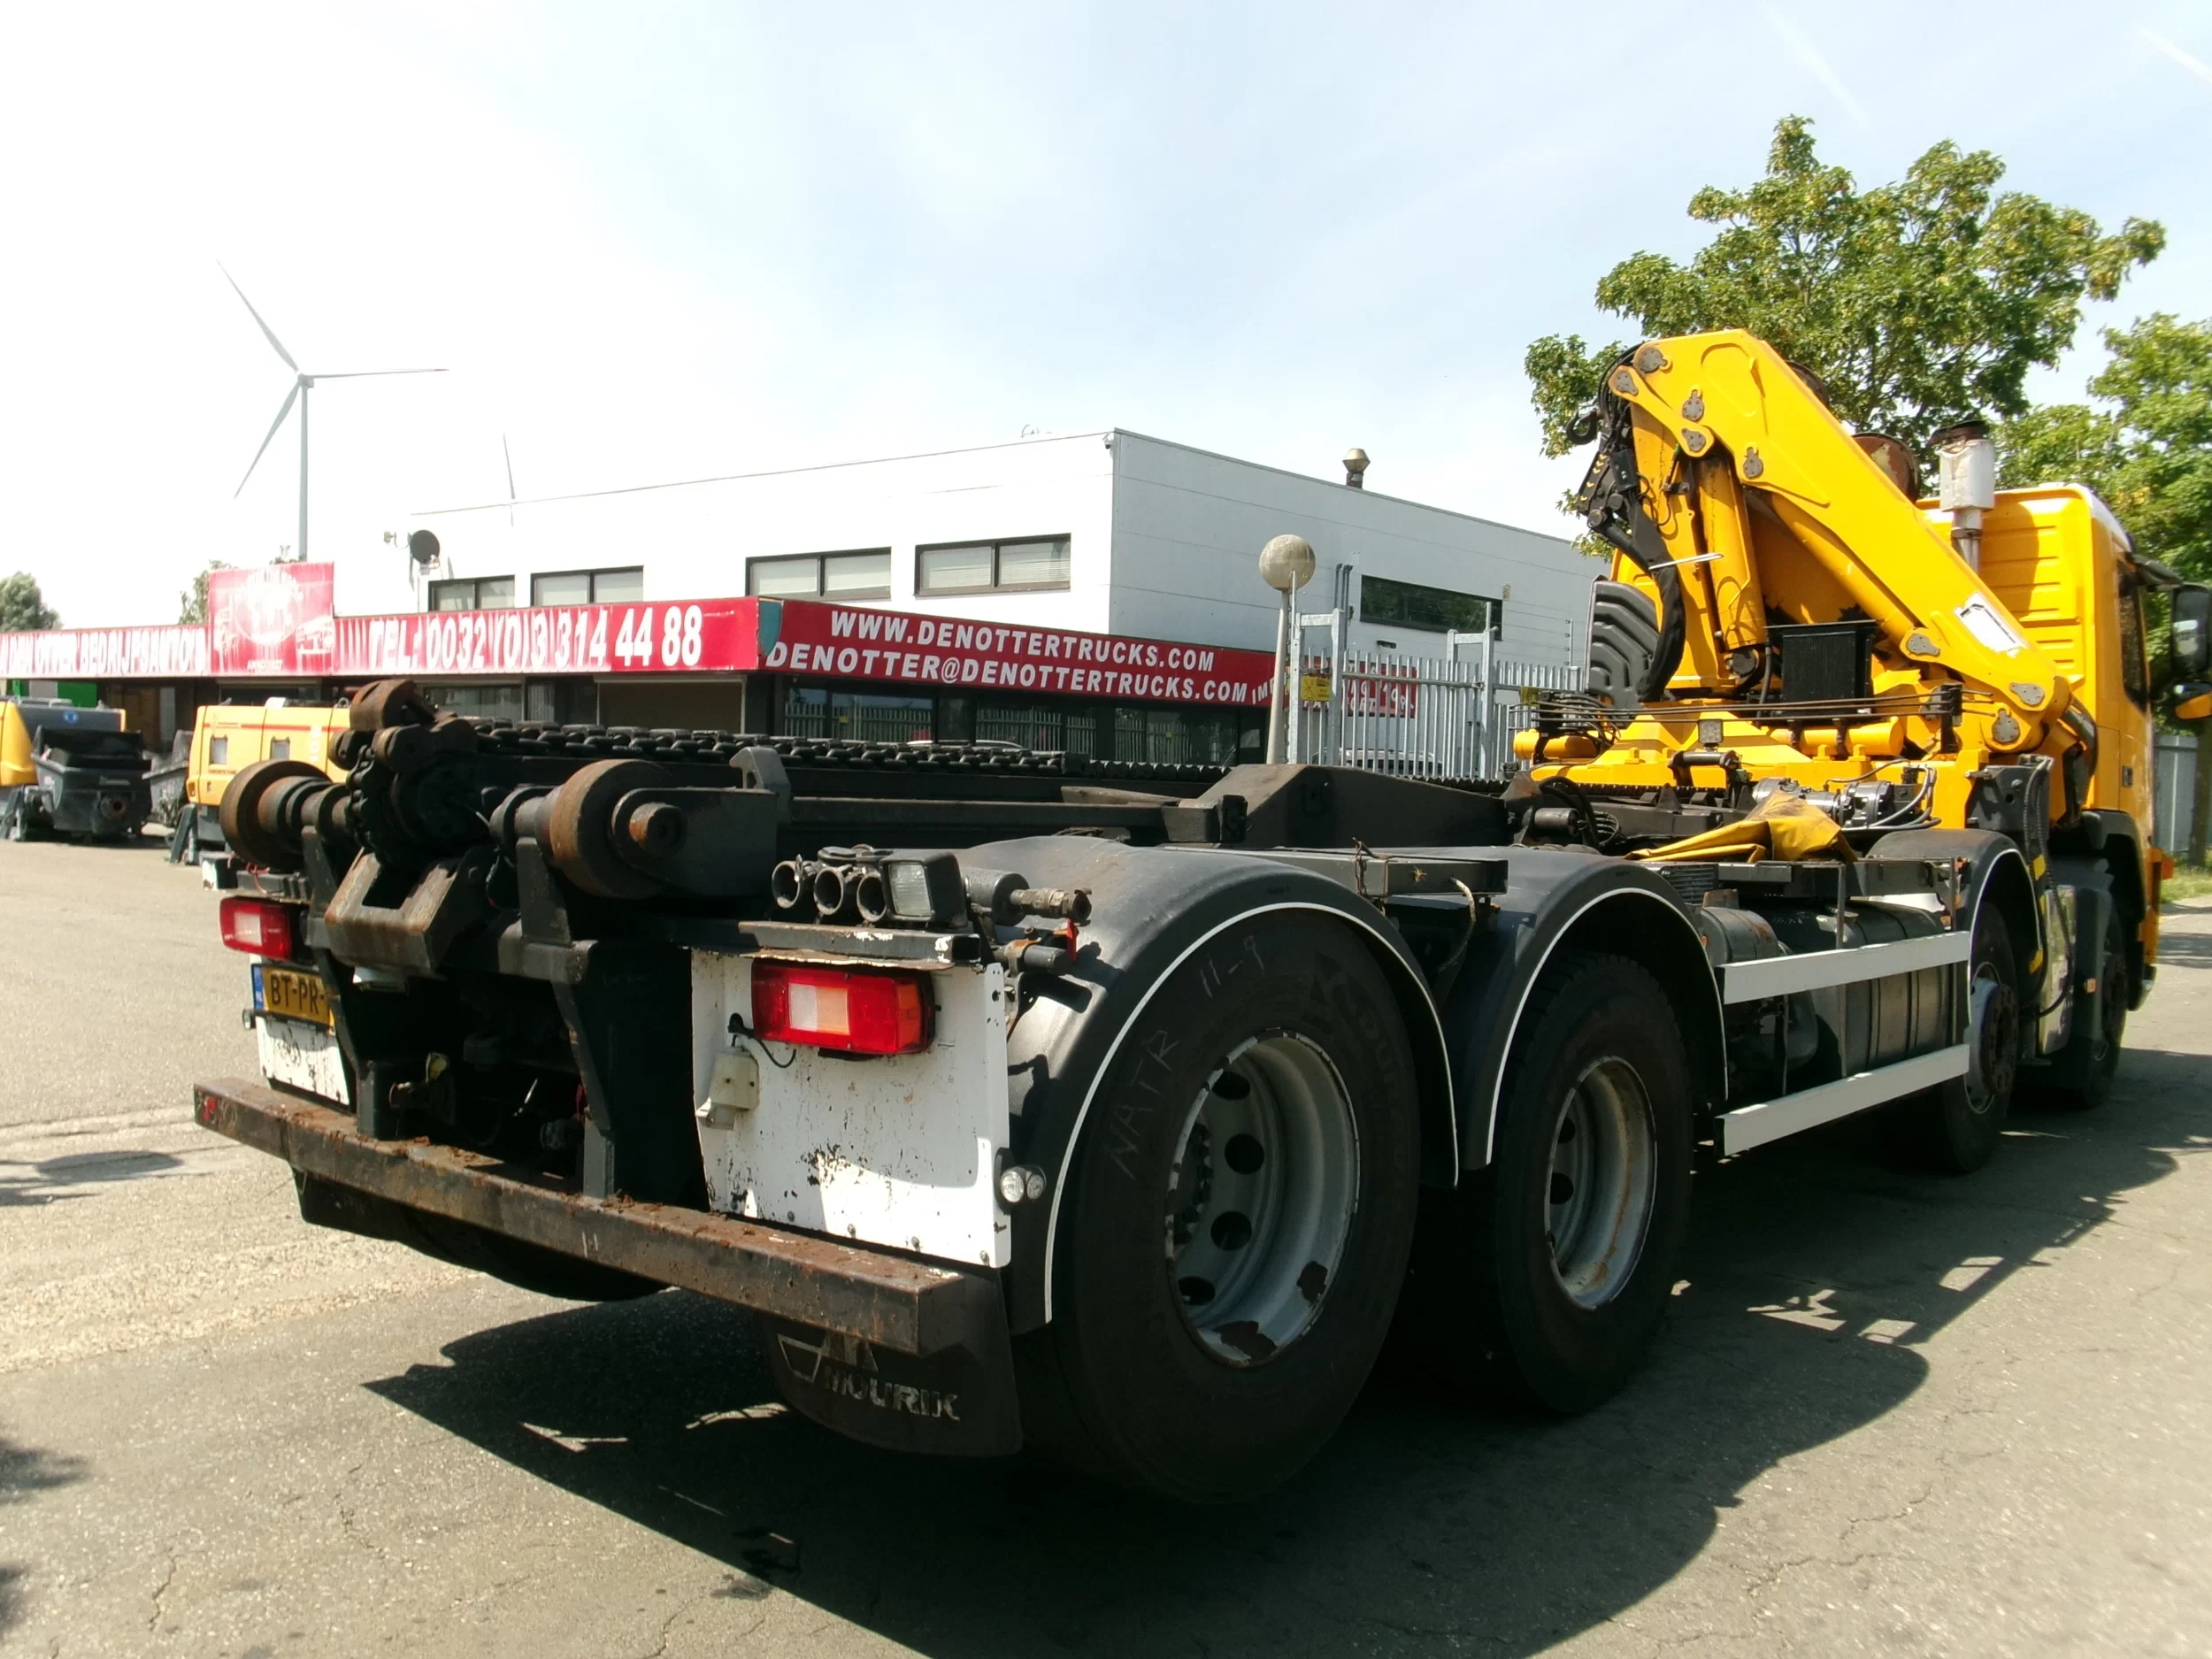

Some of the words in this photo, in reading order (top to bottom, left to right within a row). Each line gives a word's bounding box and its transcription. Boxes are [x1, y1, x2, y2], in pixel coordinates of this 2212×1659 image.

[426, 614, 486, 670] 0032
[554, 611, 609, 668] 314
[615, 606, 653, 667] 44
[661, 604, 703, 666] 88
[831, 610, 1215, 672] WWW.DENOTTERTRUCKS.COM
[765, 641, 1248, 703] DENOTTER@DENOTTERTRUCKS.COM
[270, 973, 325, 1015] BT-PR-
